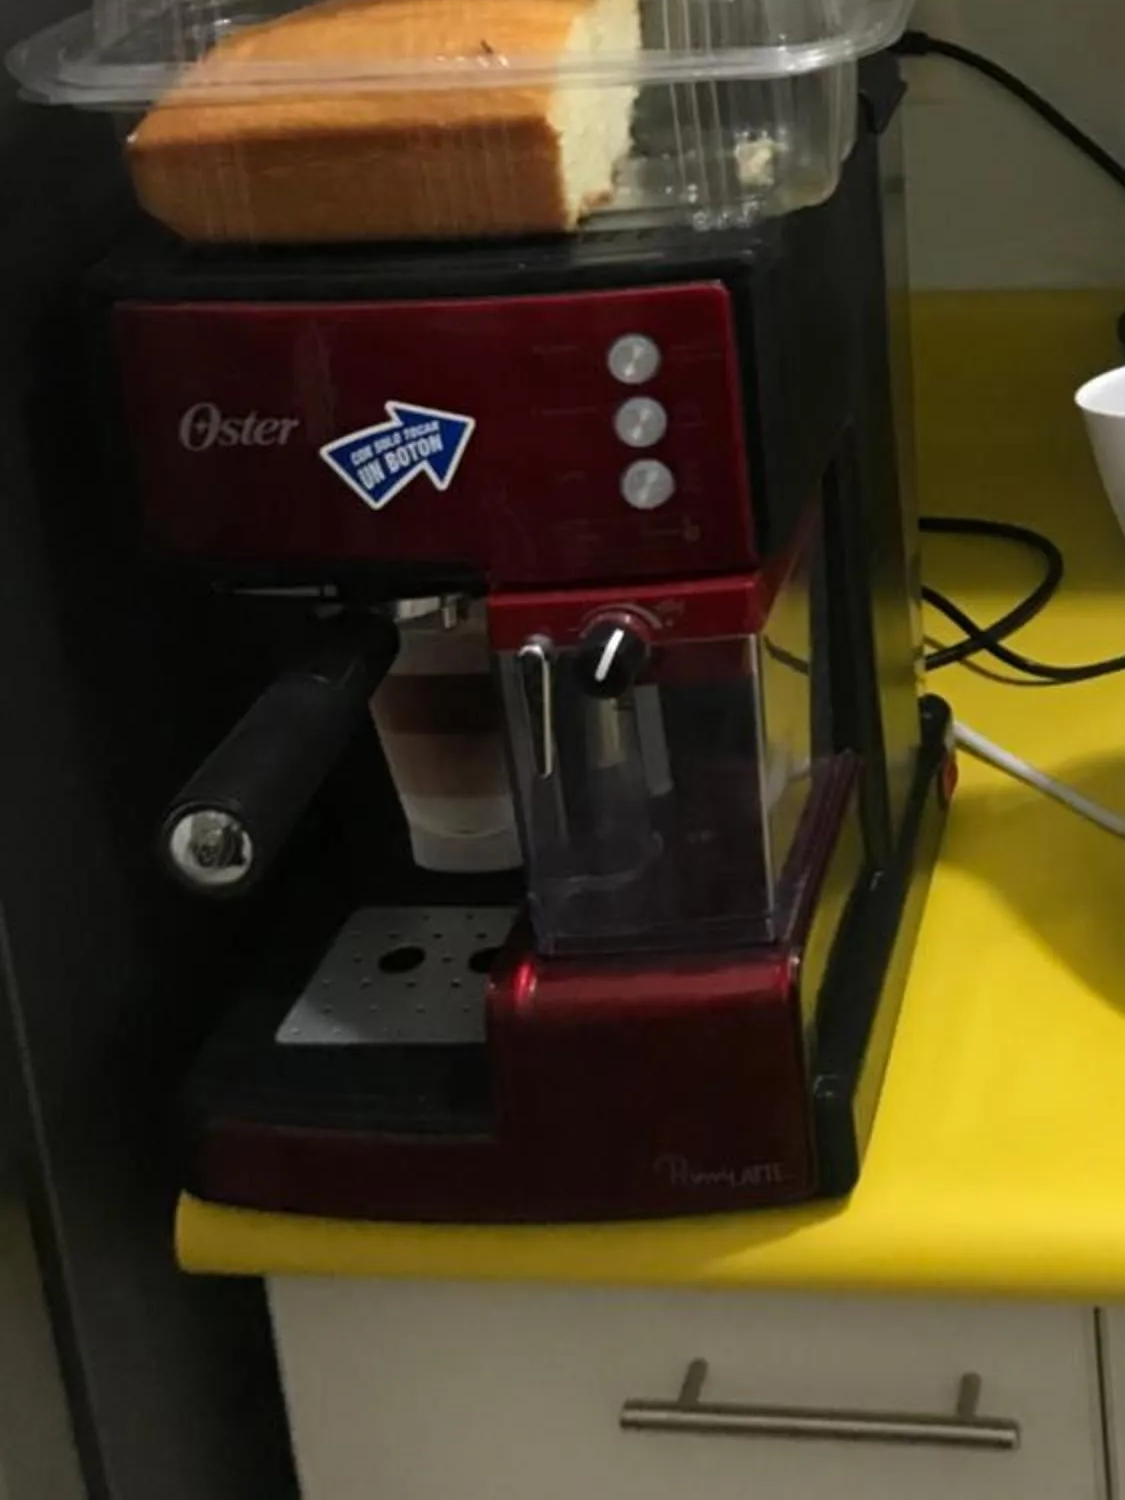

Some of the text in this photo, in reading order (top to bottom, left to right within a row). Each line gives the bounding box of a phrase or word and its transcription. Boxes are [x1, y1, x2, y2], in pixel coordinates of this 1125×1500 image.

[178, 402, 300, 451] Oster
[357, 433, 444, 490] UN BOTON
